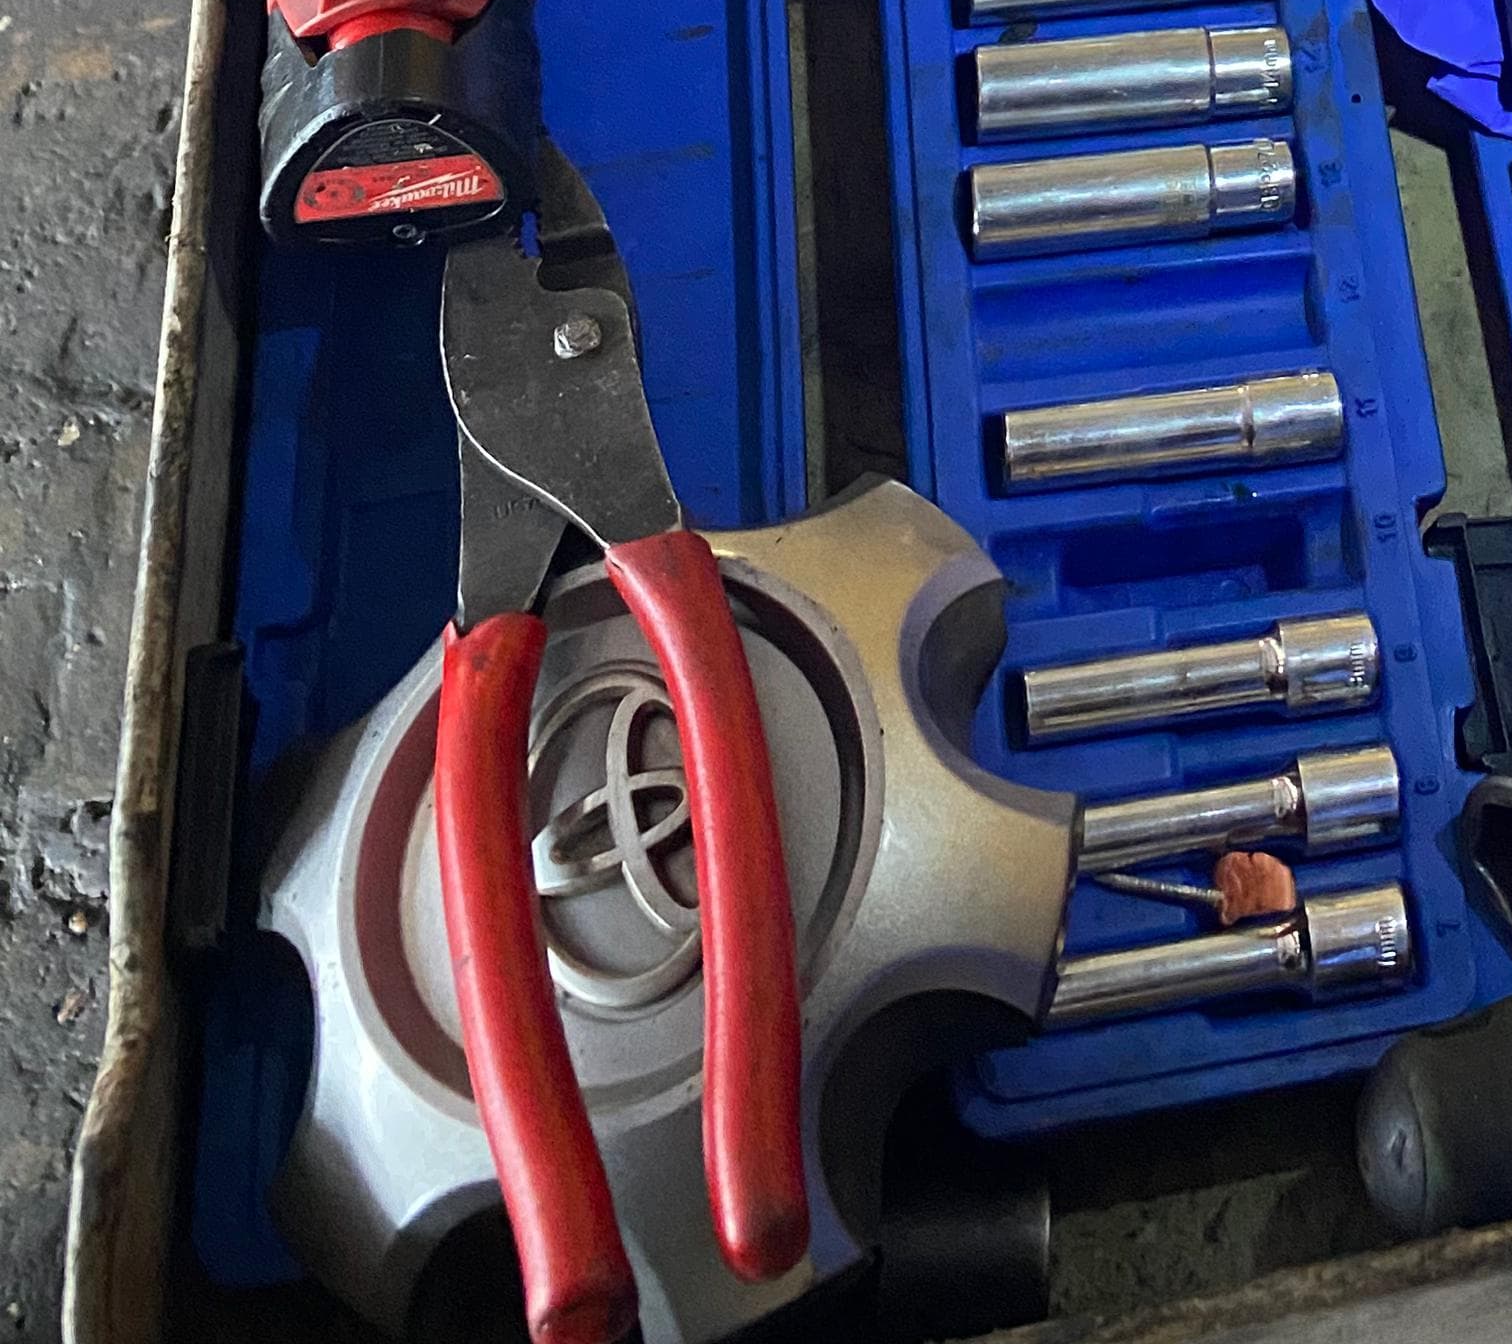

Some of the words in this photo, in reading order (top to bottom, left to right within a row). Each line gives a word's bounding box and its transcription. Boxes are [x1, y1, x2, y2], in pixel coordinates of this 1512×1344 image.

[368, 175, 484, 212] Milwaukee
[1373, 514, 1397, 544] 10
[1435, 920, 1461, 939] 7
